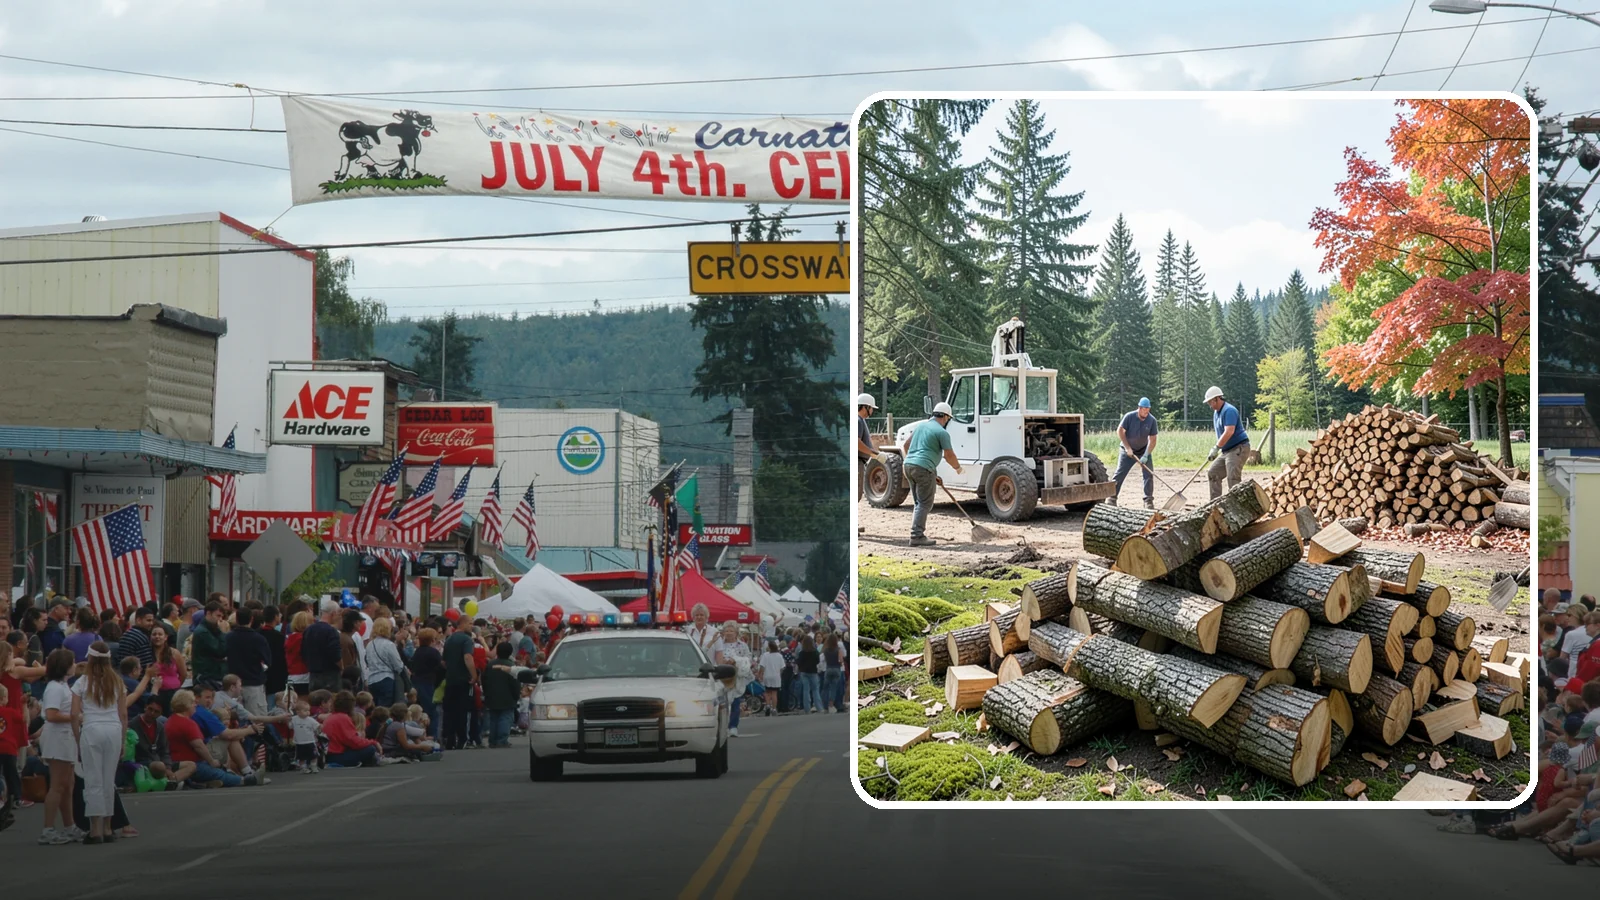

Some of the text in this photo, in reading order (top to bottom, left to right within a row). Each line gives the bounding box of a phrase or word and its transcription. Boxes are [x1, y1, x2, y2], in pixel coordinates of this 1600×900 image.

[481, 141, 605, 192] JULY
[632, 150, 746, 198] 4th.
[697, 254, 850, 280] CROSSWA
[282, 380, 374, 420] ACE
[405, 409, 452, 422] CEDAR
[283, 421, 371, 436] Hardware
[416, 428, 477, 447] Coca-Cola
[353, 467, 386, 480] Simpl
[83, 485, 155, 495] St. Vincent de Paul
[688, 526, 741, 535] CRNATION
[699, 535, 730, 543] GLASS
